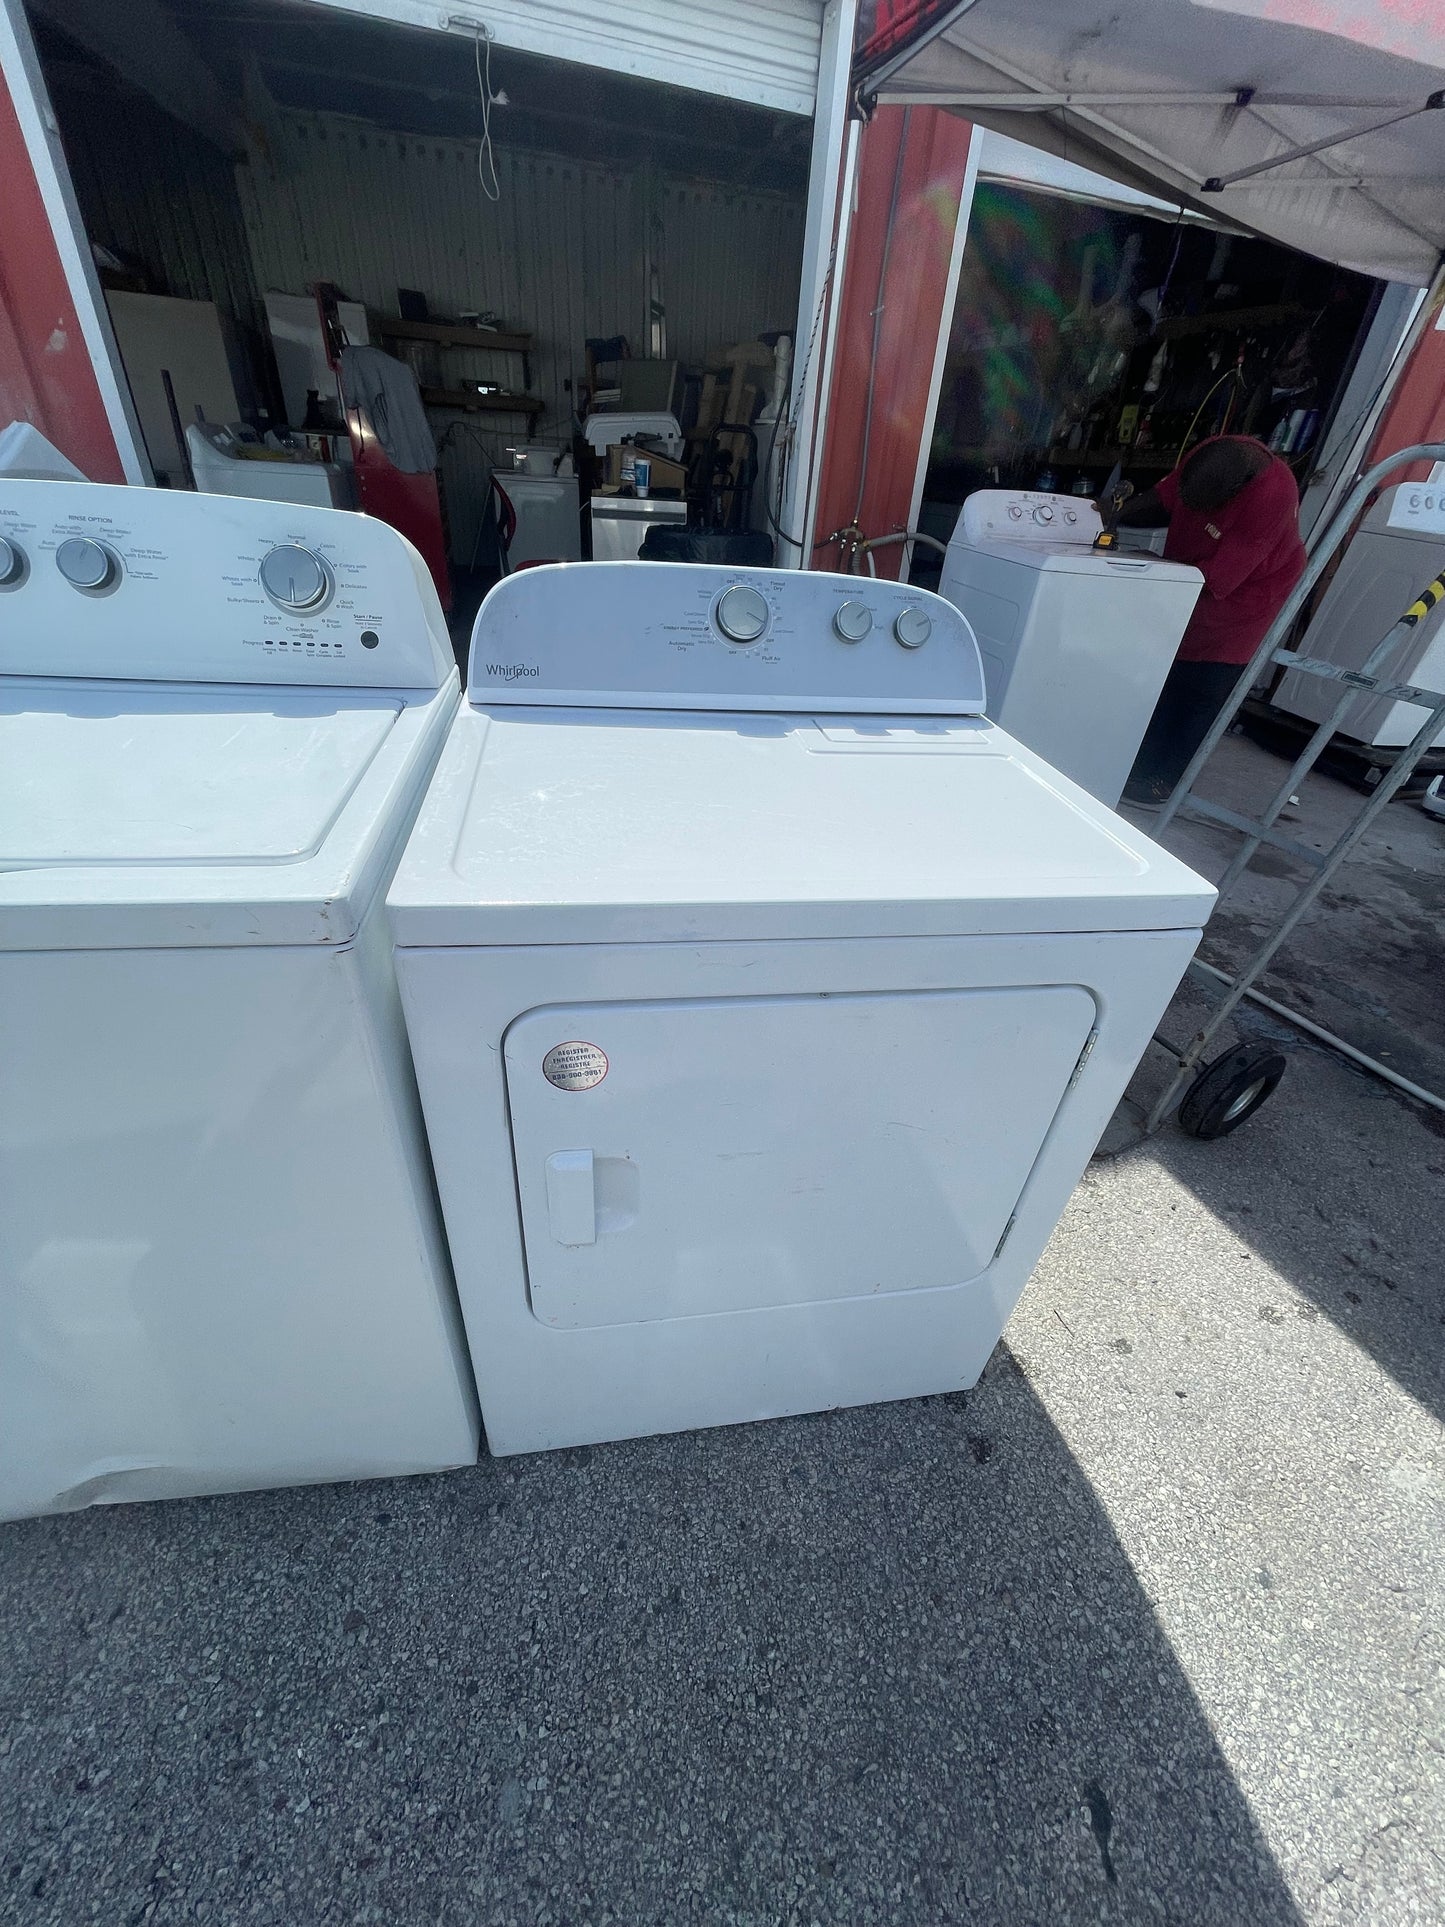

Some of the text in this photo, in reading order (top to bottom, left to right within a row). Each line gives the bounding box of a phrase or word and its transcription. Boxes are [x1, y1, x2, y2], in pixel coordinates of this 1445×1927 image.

[68, 514, 113, 524] RINSE OPTION
[485, 664, 540, 681] Whirlpool
[558, 1048, 588, 1056] REGISTER
